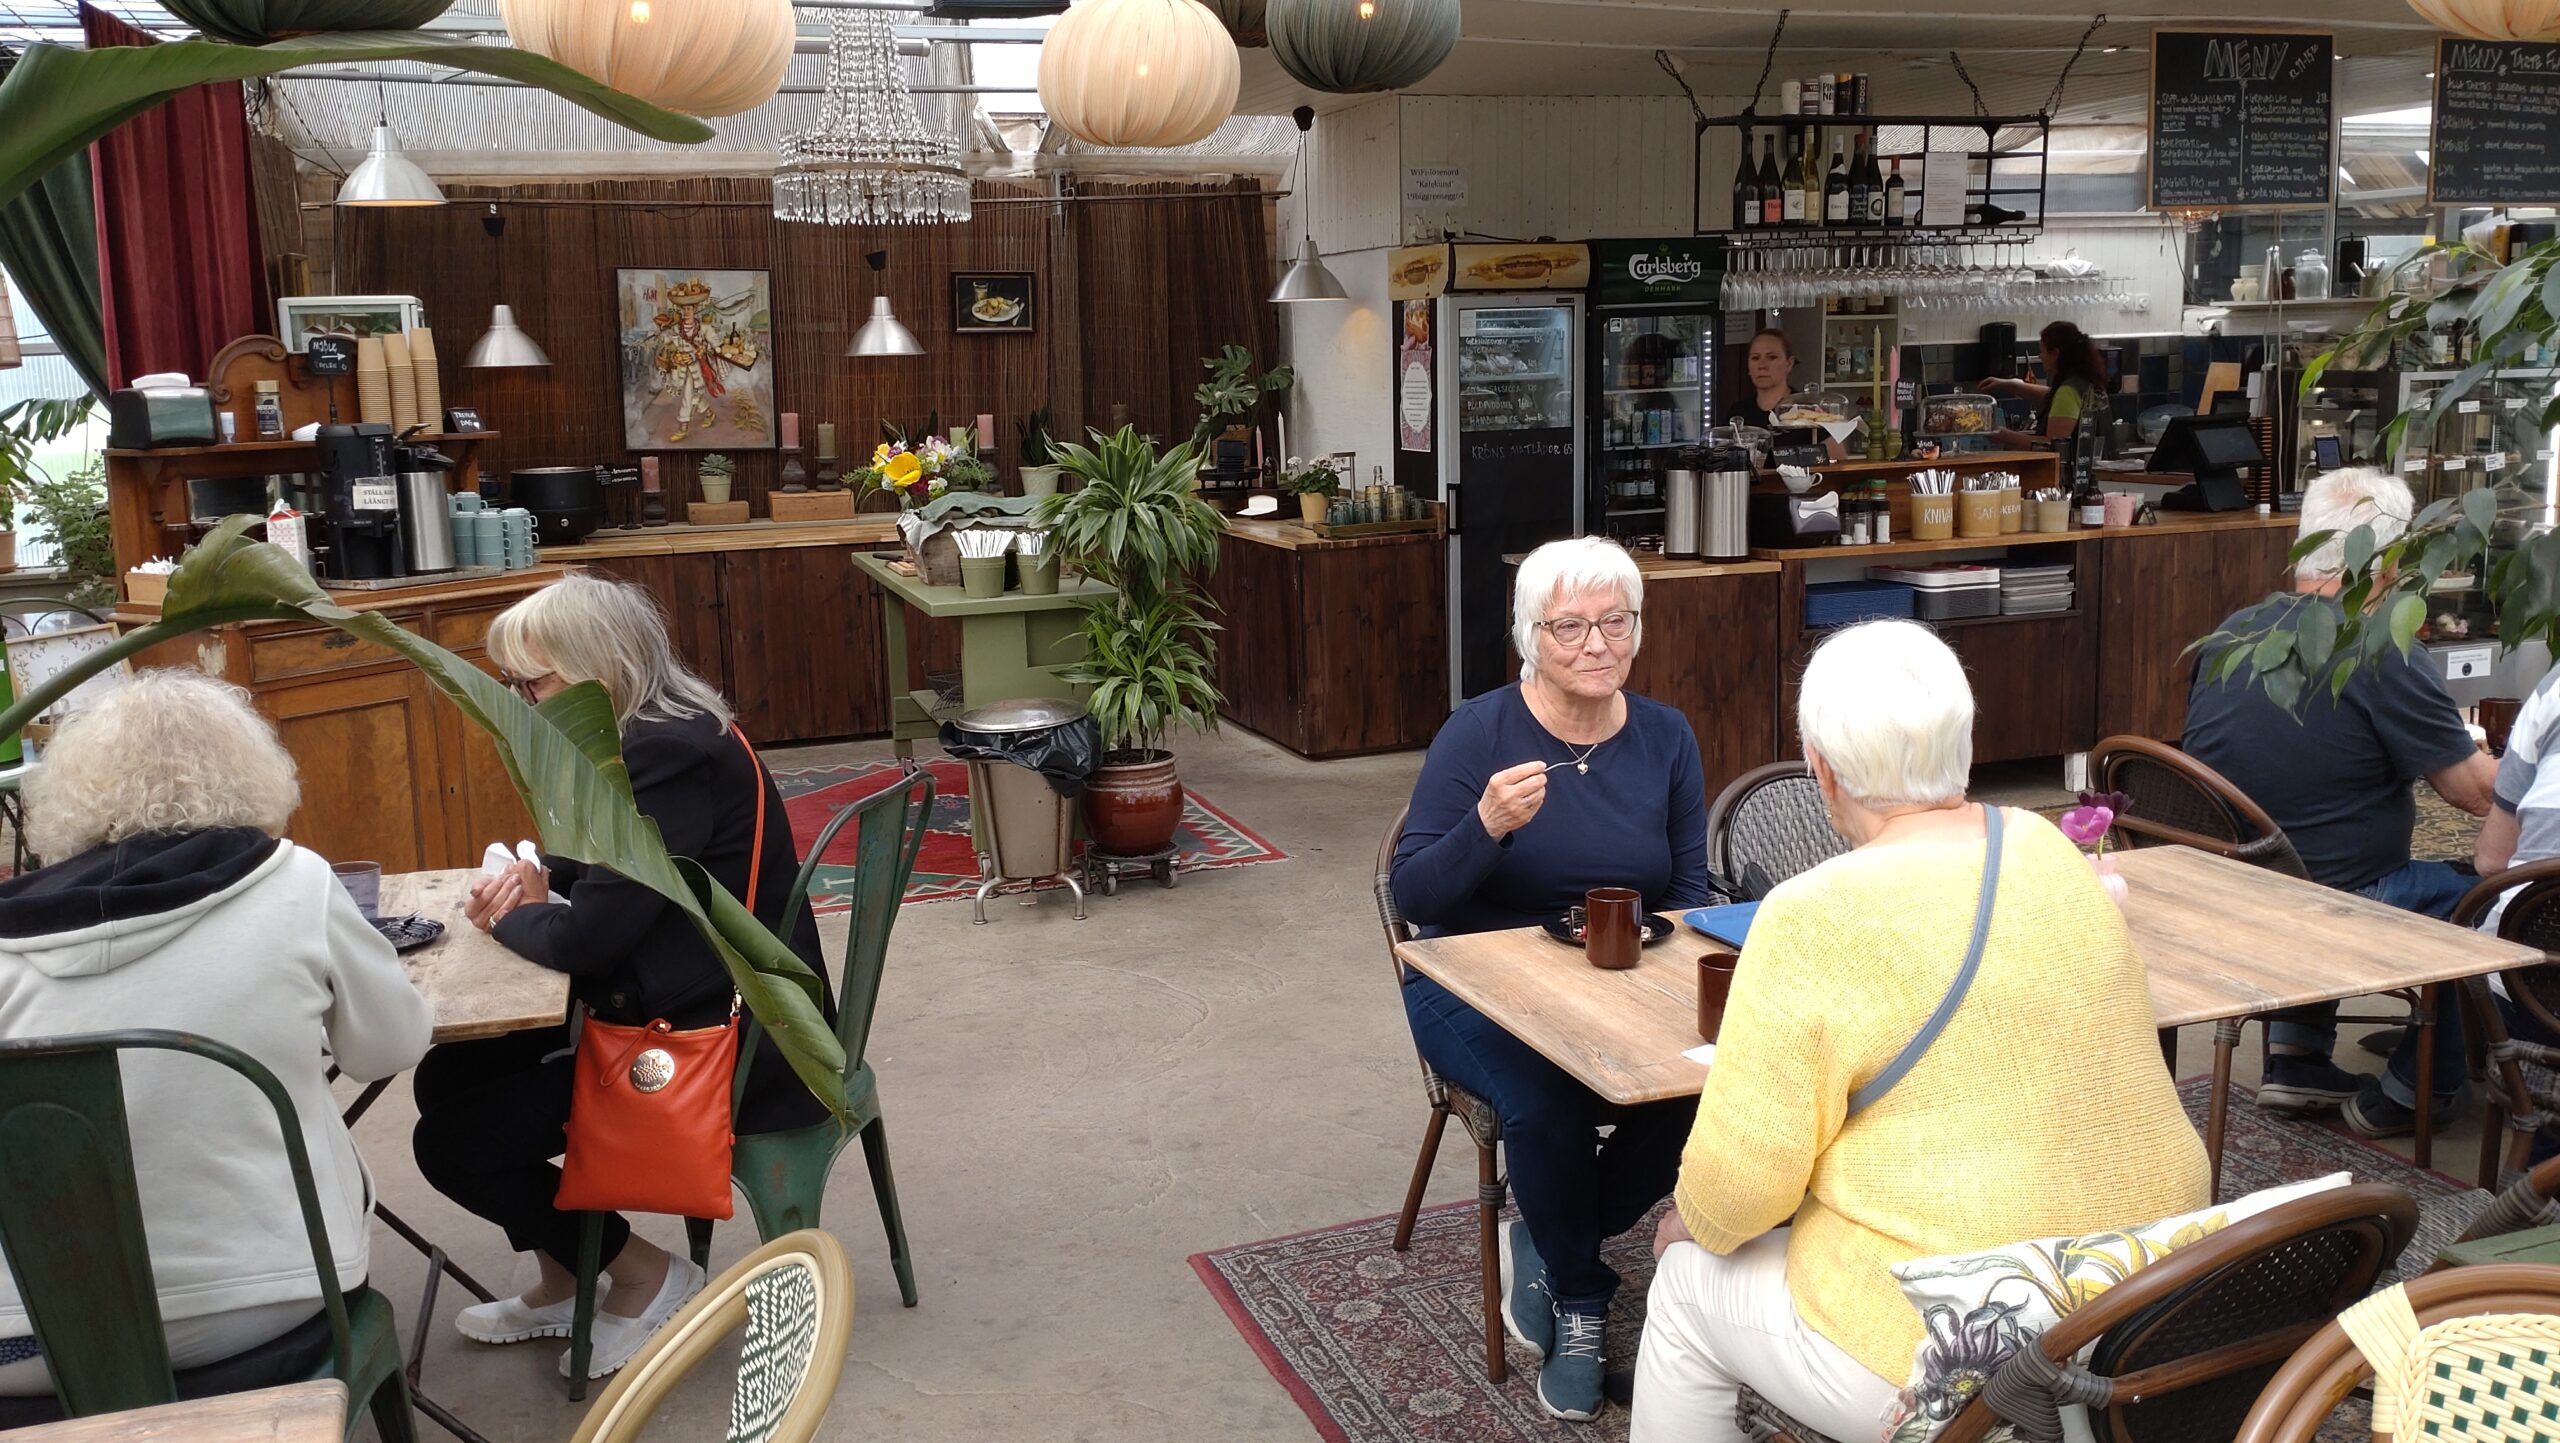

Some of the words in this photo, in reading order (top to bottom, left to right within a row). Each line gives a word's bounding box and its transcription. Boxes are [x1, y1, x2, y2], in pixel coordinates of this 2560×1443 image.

[2203, 39, 2289, 80] MENY
[2451, 43, 2503, 71] MENY
[1629, 253, 1701, 280] Carlsberg
